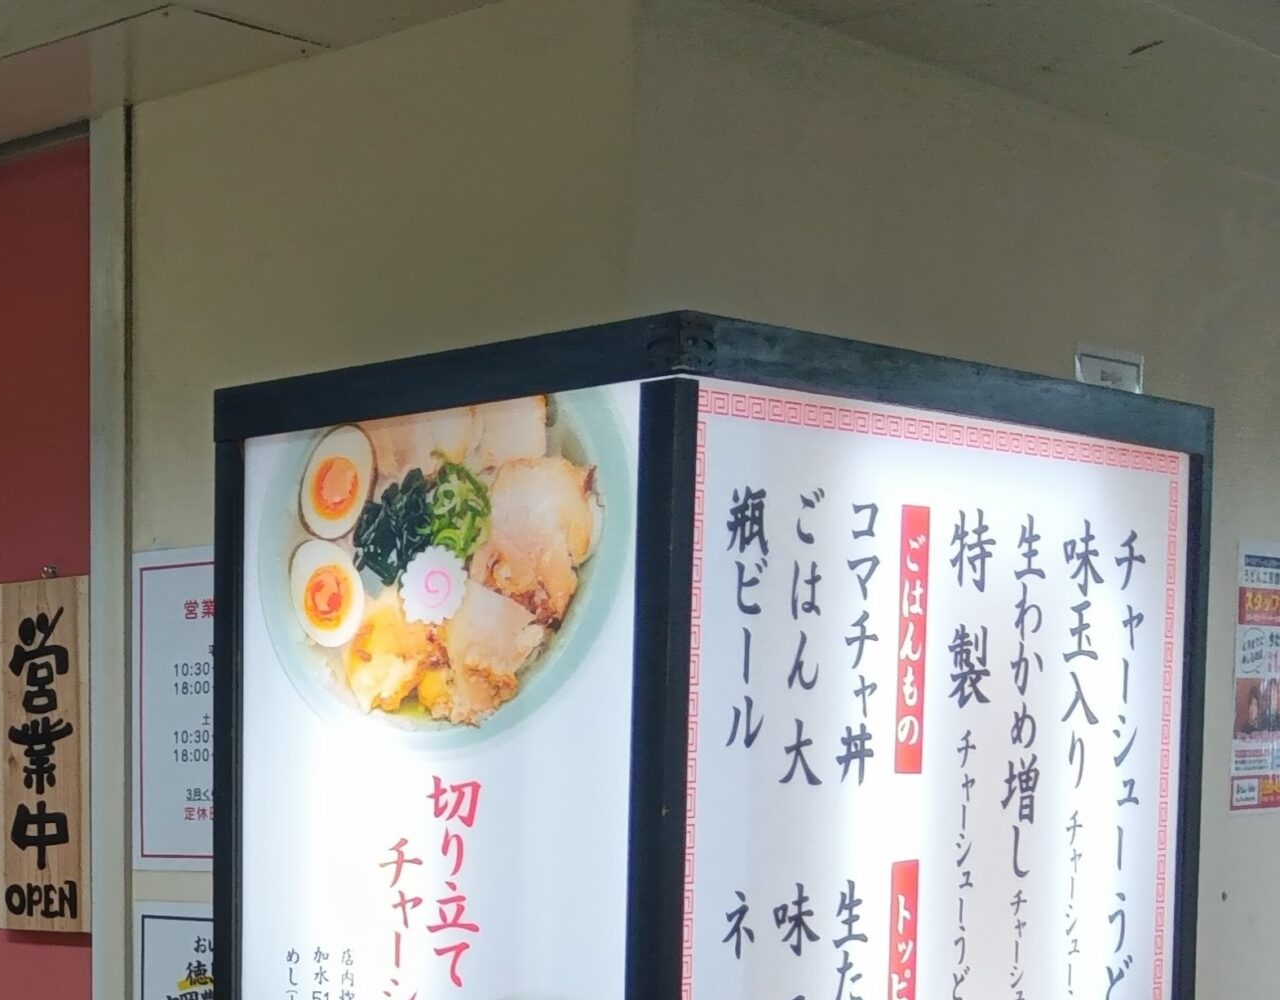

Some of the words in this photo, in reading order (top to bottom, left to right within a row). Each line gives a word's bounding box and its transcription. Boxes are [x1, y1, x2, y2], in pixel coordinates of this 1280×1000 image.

[8, 606, 74, 870] 営業中
[725, 485, 769, 749] 瓶ビール
[836, 502, 881, 787] コマチャ丼
[897, 534, 926, 745] ごはんもの
[948, 508, 996, 709] 特製
[1001, 514, 1047, 879] 生わかめ増し
[1061, 519, 1105, 789] 味玉入り
[5, 880, 78, 919] OPEN
[426, 775, 481, 988] 切り立て
